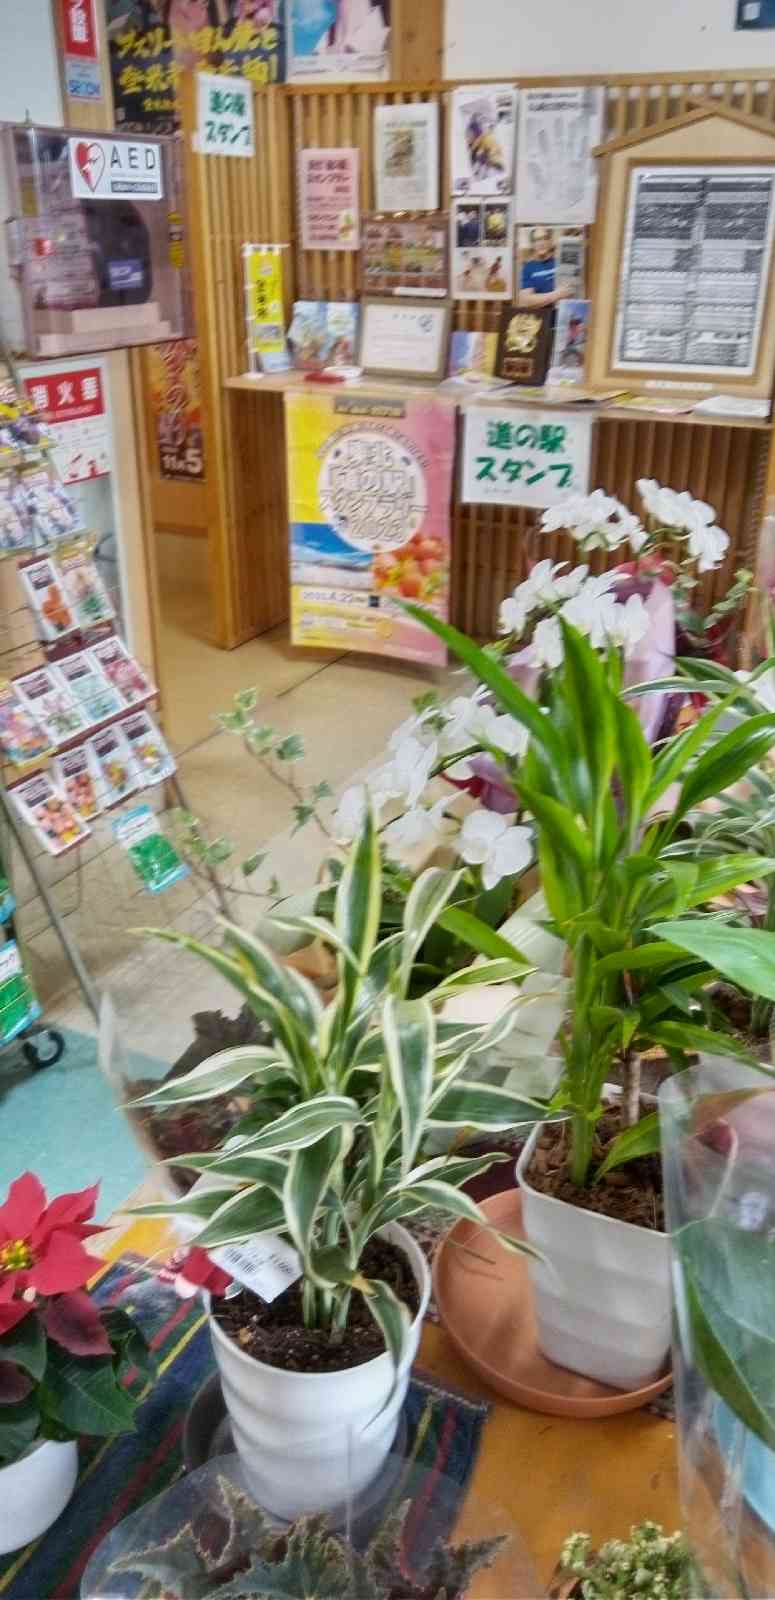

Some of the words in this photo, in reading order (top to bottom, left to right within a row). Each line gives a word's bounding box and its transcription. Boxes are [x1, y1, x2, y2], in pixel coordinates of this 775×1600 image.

[209, 88, 246, 117] 道の駅
[110, 145, 157, 171] AED
[29, 376, 98, 412] 消火器
[485, 420, 567, 454] 道の駅
[473, 456, 575, 489] スタンプ
